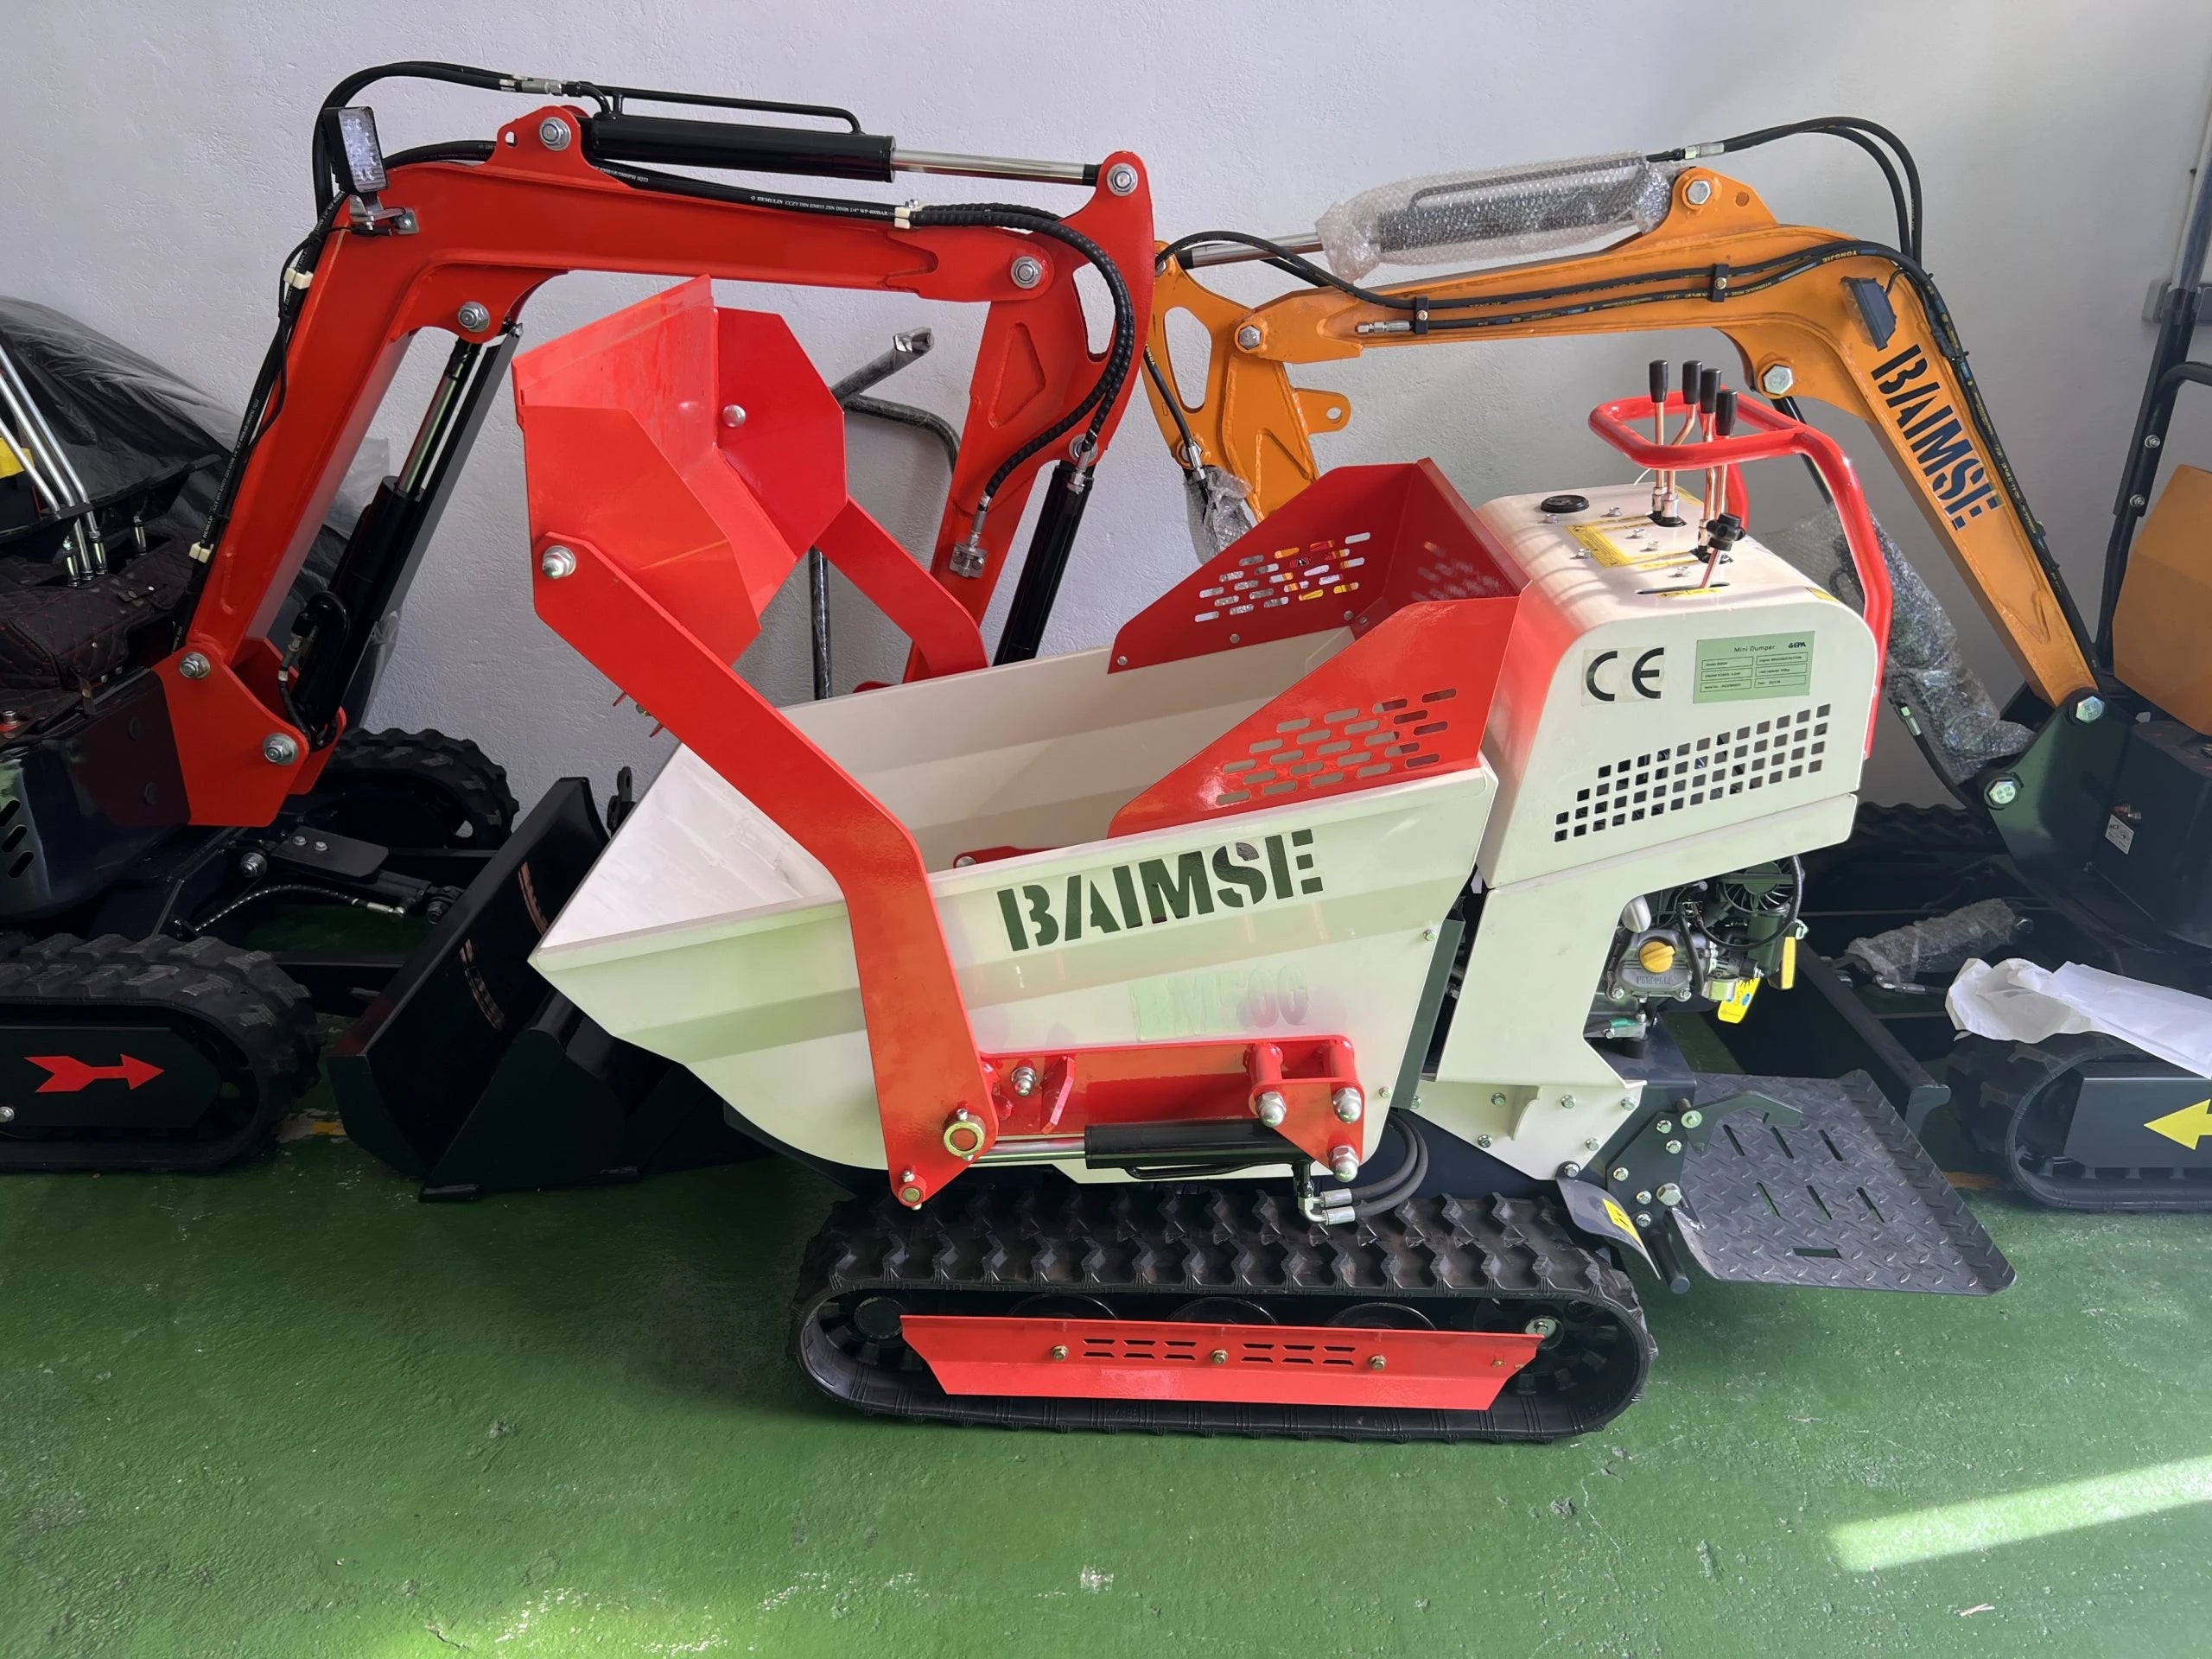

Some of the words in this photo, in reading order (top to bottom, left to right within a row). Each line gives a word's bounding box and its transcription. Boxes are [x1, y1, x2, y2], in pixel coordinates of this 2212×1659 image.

[1822, 250, 1858, 263] YONGJIE
[1871, 344, 2004, 531] BAIMSE
[1586, 647, 1664, 702] CE
[996, 829, 1324, 952] BAIMSE
